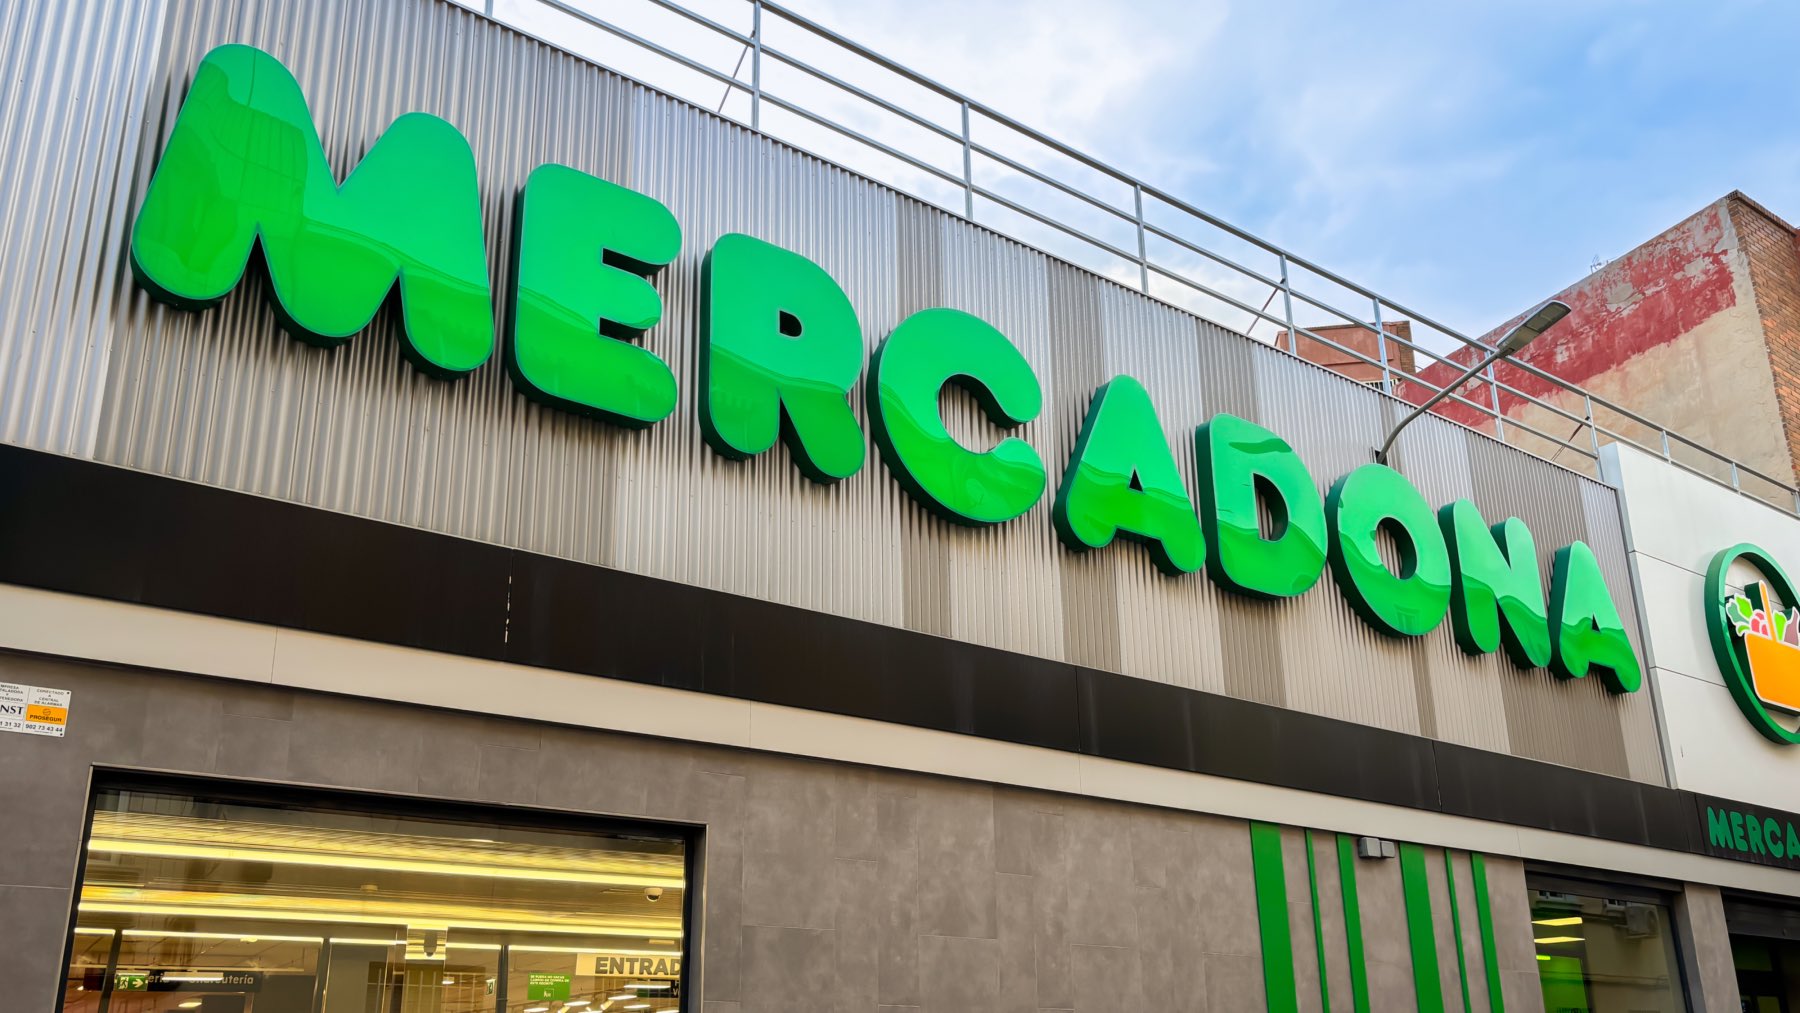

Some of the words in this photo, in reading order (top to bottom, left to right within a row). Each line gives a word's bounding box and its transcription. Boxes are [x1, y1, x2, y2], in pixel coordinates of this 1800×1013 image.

[131, 43, 1642, 694] MERCADONA
[30, 714, 62, 722] PROSEGUR
[1707, 806, 1800, 861] MERCA
[594, 956, 681, 976] ENTRAD
